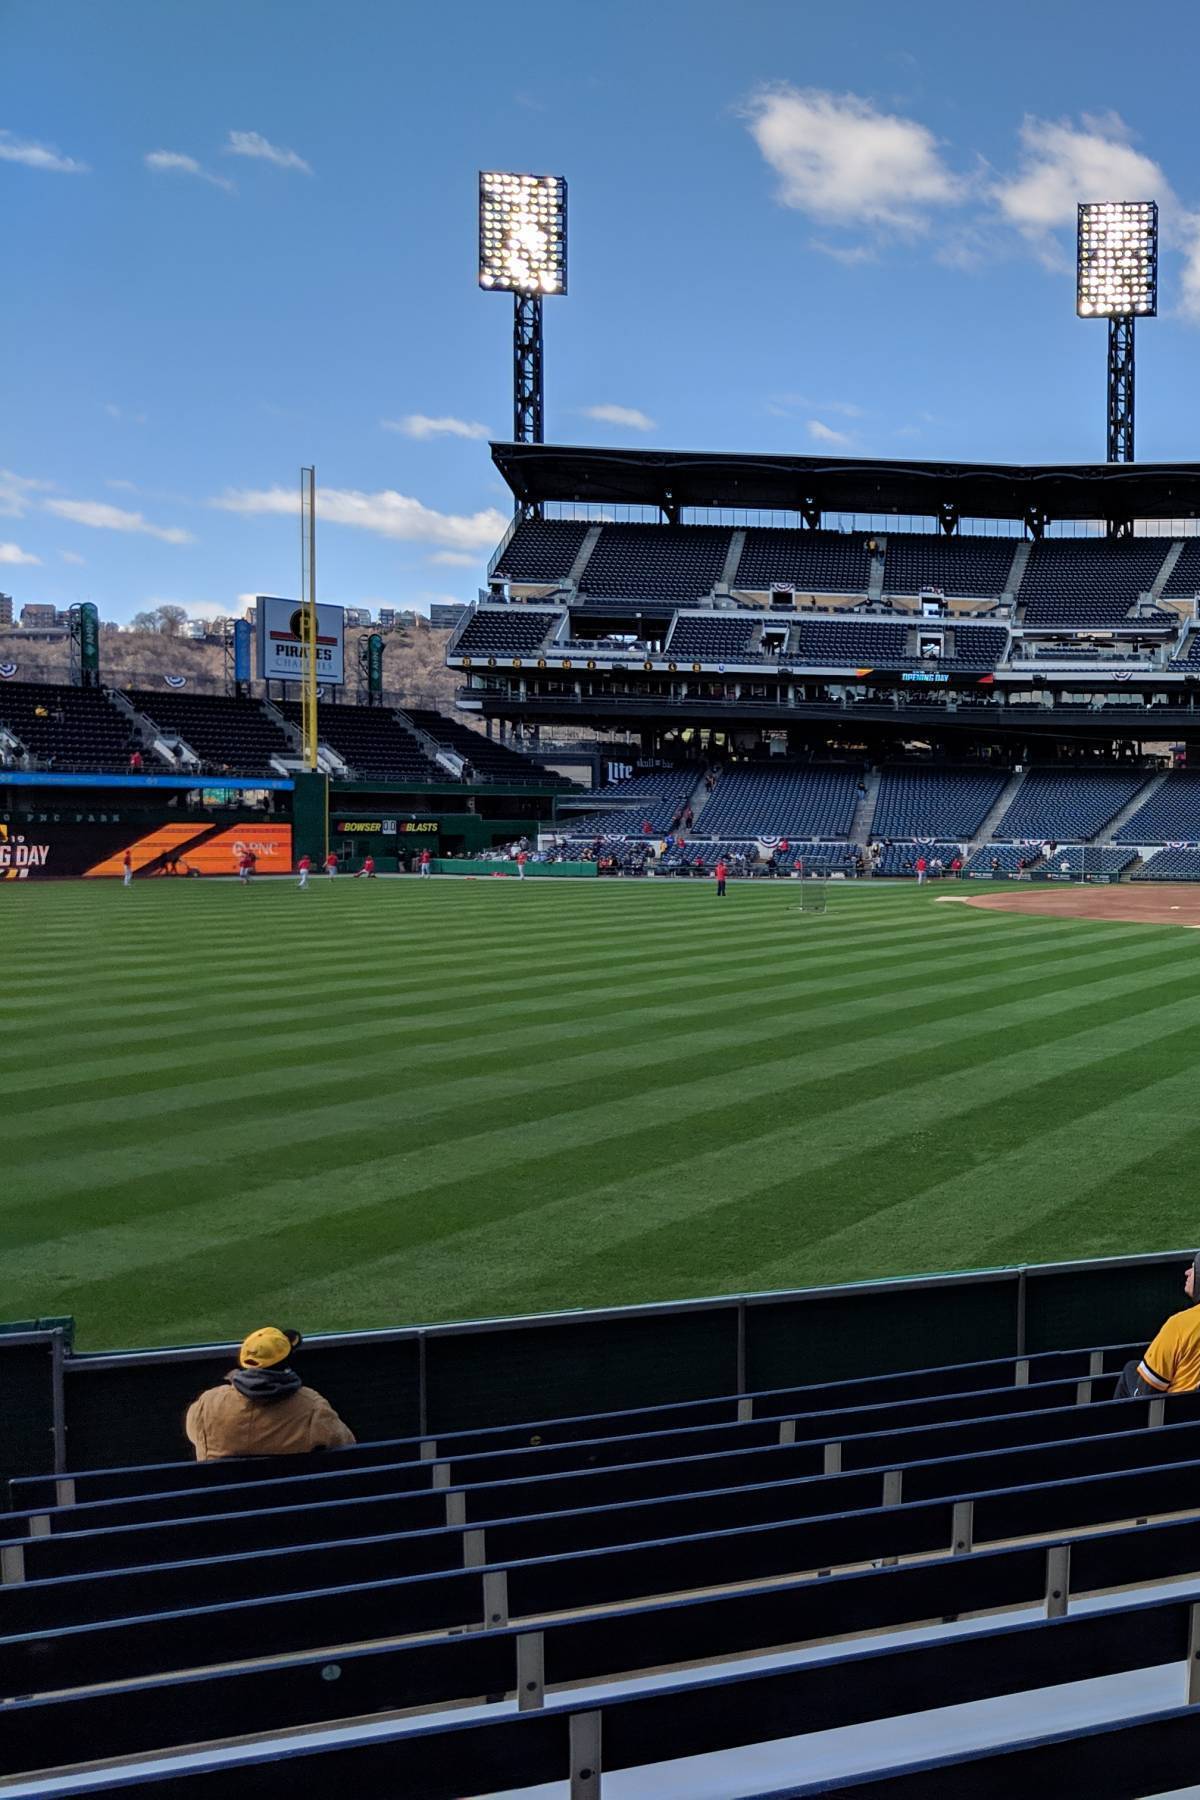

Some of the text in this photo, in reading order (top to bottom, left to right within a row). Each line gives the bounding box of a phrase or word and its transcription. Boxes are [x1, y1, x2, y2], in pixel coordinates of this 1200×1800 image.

[608, 762, 633, 784] Lite
[406, 822, 438, 832] BLASTS
[16, 845, 50, 866] DAY
